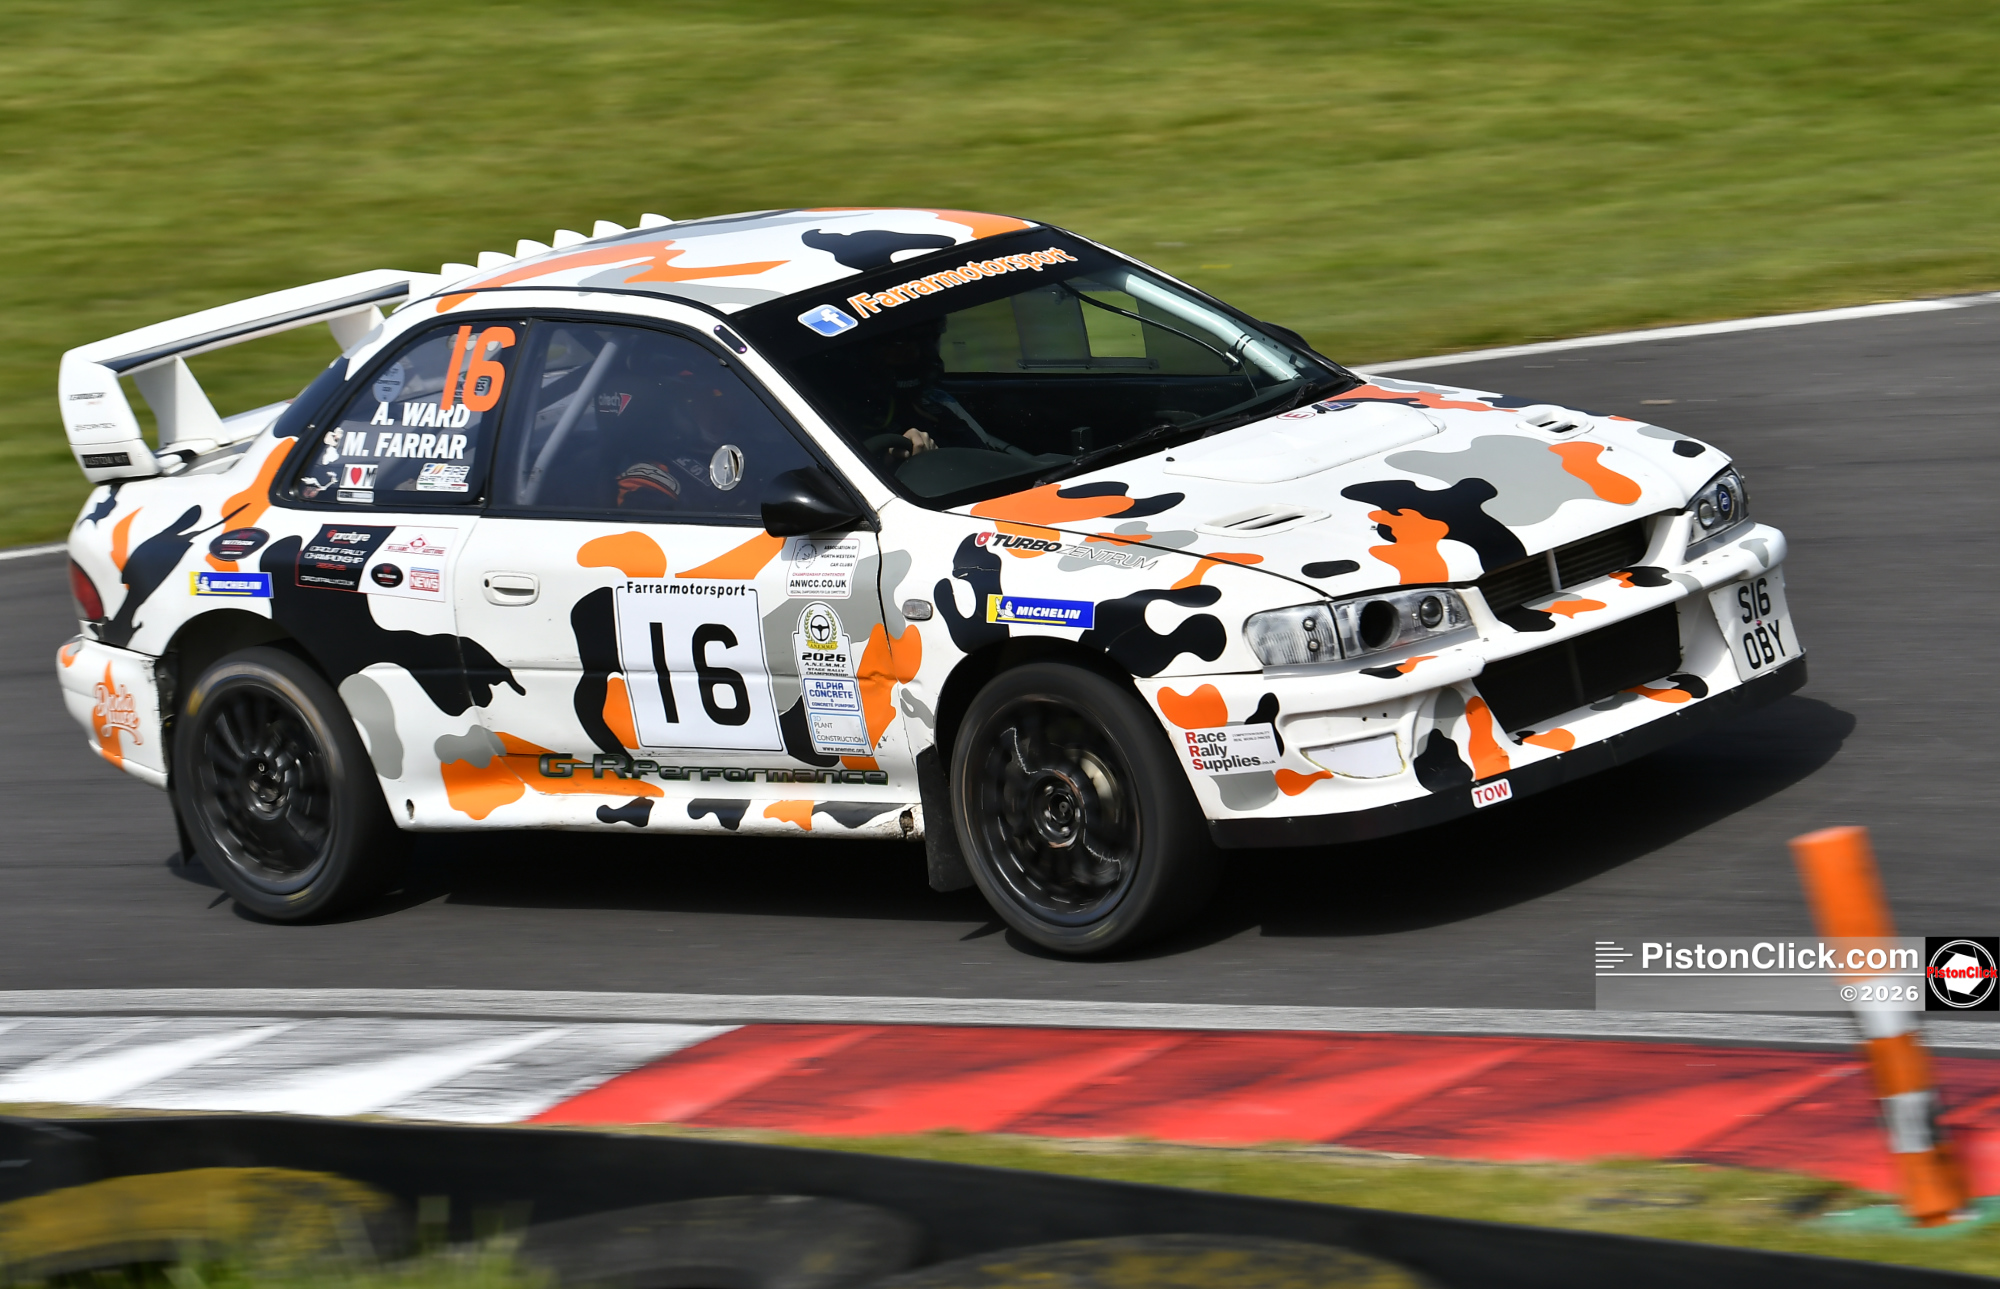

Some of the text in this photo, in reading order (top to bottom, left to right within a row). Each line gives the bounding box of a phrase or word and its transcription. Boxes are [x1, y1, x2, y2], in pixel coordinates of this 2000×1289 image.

[440, 325, 516, 412] 16
[370, 402, 471, 428] A. WARD
[342, 431, 468, 460] M. FARRAR
[329, 531, 372, 545] protyre
[308, 545, 368, 556] CIRCUIT RALLY
[304, 552, 365, 564] CHAMPIONSHIP
[209, 580, 263, 590] MICHELIN
[411, 577, 439, 589] NEWS
[626, 581, 746, 598] Farrarmotorsport
[789, 579, 847, 588] ANWCC.CO.UK
[1737, 577, 1771, 624] S16
[1016, 605, 1082, 620] MICHELIN
[1743, 619, 1786, 670] OBY
[801, 652, 847, 663] 2026
[649, 622, 751, 726] 16
[815, 681, 844, 690] ALPHA
[809, 689, 854, 699] CONCRETE
[814, 721, 833, 729] PLANT
[816, 734, 865, 743] CONSTRUCTION
[1185, 731, 1227, 744] Race
[1188, 743, 1228, 758] Rally
[1474, 782, 1508, 804] TOW
